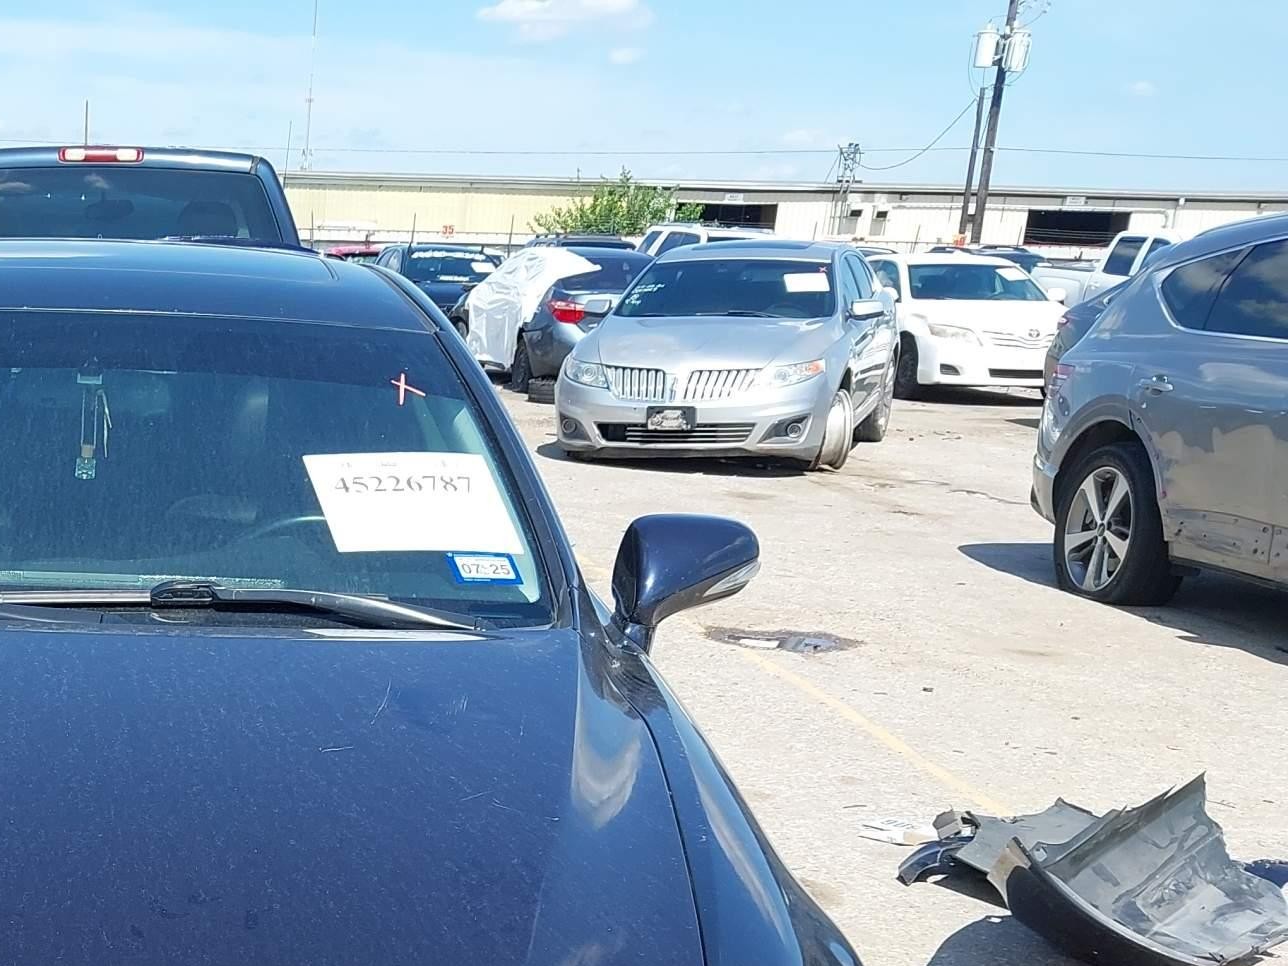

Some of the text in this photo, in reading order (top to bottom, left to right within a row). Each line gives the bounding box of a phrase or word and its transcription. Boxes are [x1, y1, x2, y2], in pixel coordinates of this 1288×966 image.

[334, 473, 472, 494] 45226787
[460, 563, 480, 575] 07
[489, 563, 511, 575] 25
